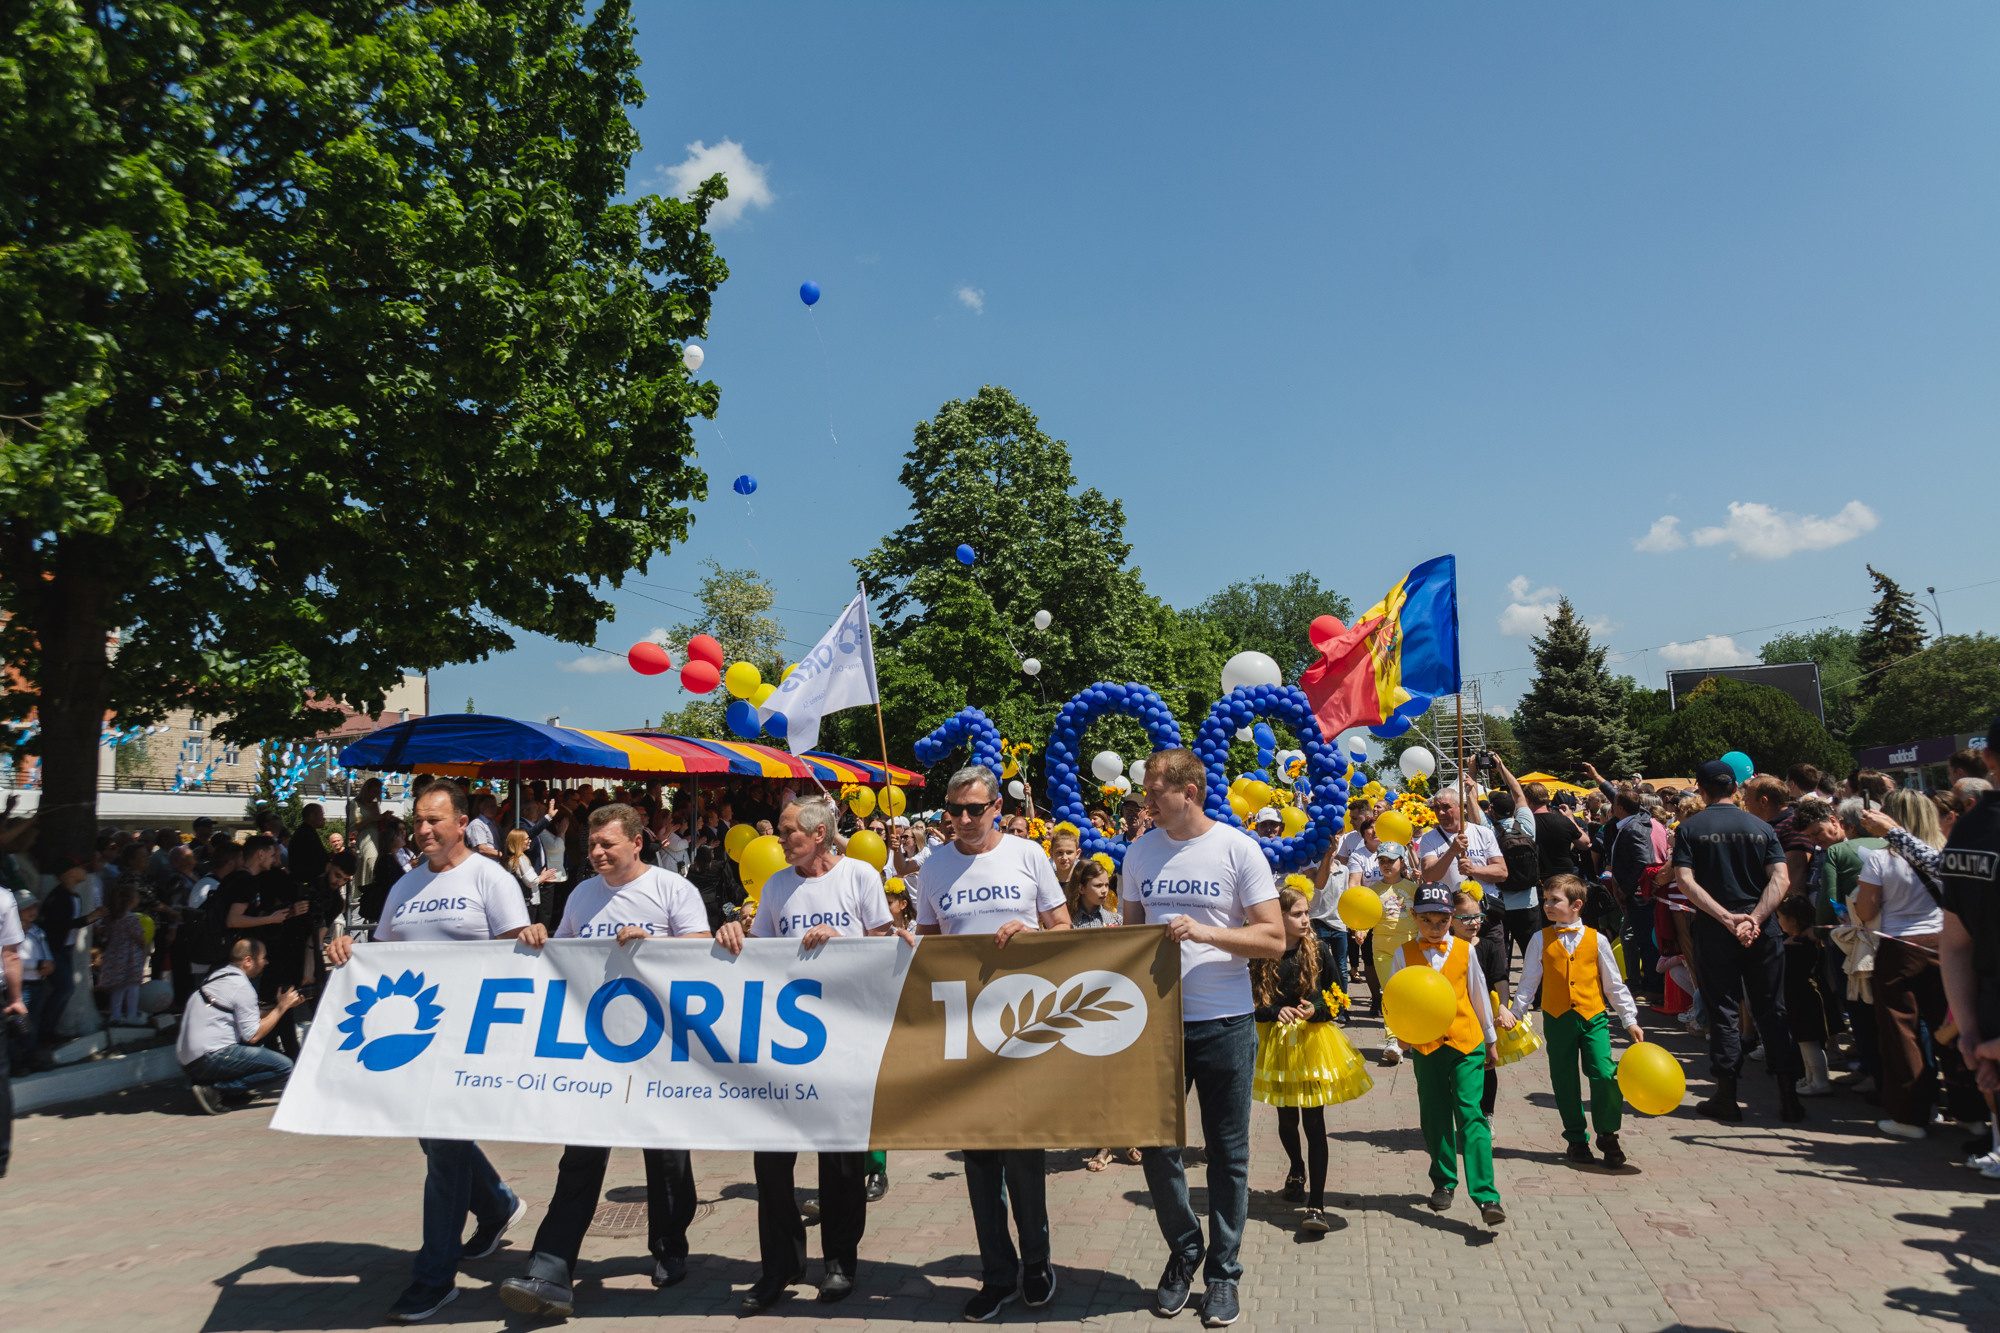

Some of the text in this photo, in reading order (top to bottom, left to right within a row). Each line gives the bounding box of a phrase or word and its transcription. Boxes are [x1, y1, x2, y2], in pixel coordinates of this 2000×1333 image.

[957, 886, 1020, 904] FLORIS
[1158, 880, 1220, 897] FLORIS
[1422, 888, 1449, 900] BOY
[409, 897, 467, 913] FLORIS
[792, 912, 850, 929] FLORIS
[465, 977, 827, 1065] FLORIS
[931, 970, 1147, 1059] 100
[553, 1075, 613, 1099] Group
[646, 1080, 712, 1099] Floarea
[718, 1081, 789, 1100] Soarelui
[795, 1083, 819, 1101] SA
